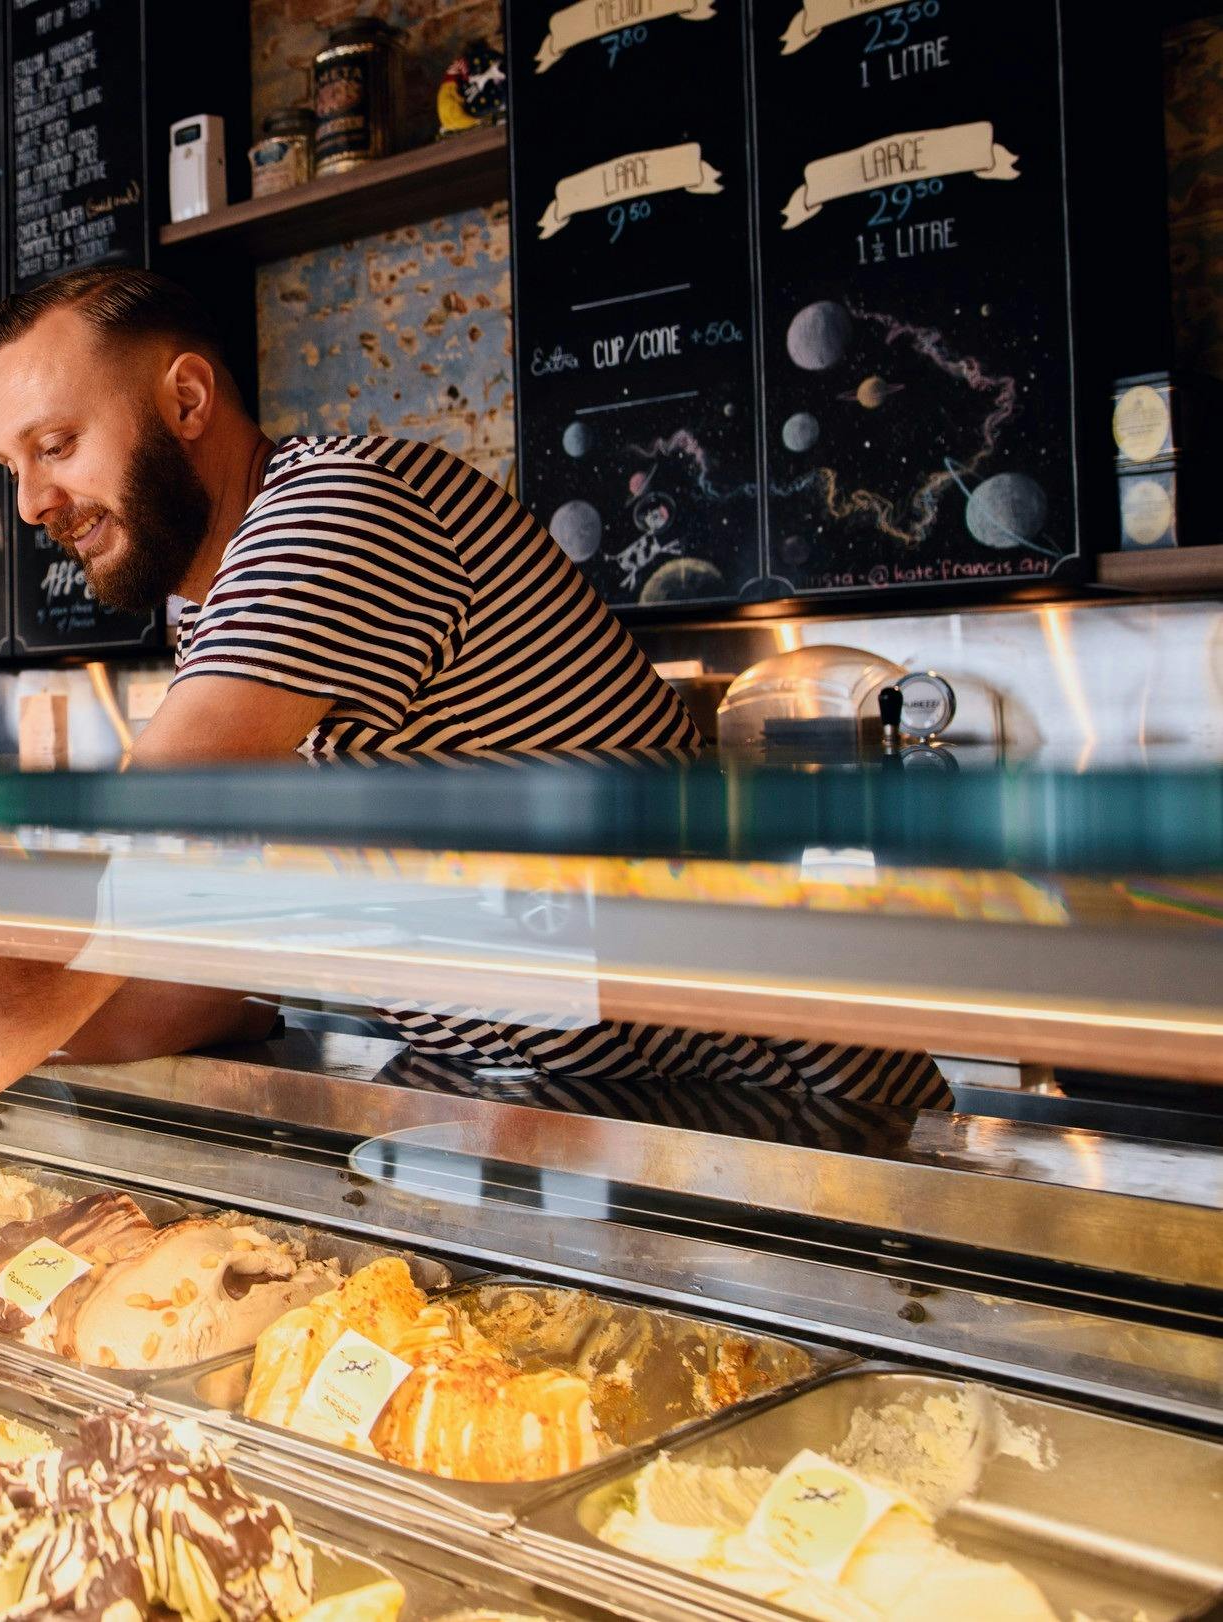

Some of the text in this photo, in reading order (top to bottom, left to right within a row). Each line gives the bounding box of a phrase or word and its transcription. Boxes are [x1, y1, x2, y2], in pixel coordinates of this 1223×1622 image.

[888, 36, 950, 80] LITRE
[860, 136, 926, 183] LARGE
[896, 218, 959, 258] LITRE
